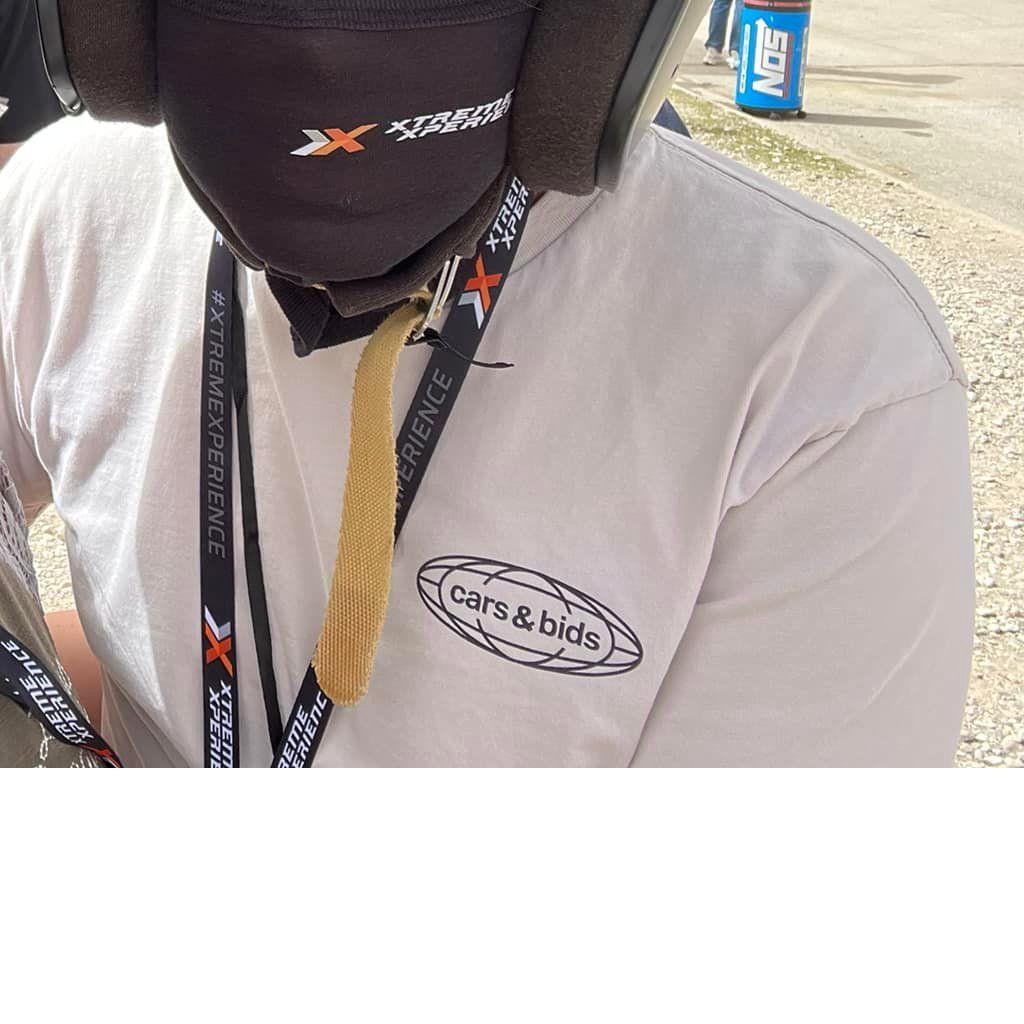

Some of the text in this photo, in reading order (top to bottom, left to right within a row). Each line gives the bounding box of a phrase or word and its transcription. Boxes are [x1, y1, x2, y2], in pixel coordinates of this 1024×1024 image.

[752, 17, 789, 97] NOS
[485, 176, 522, 253] XTREM
[501, 185, 531, 251] XPER
[397, 367, 453, 491] ERIENCE
[449, 584, 601, 651] cars & bids
[292, 691, 328, 768] ERIENC
